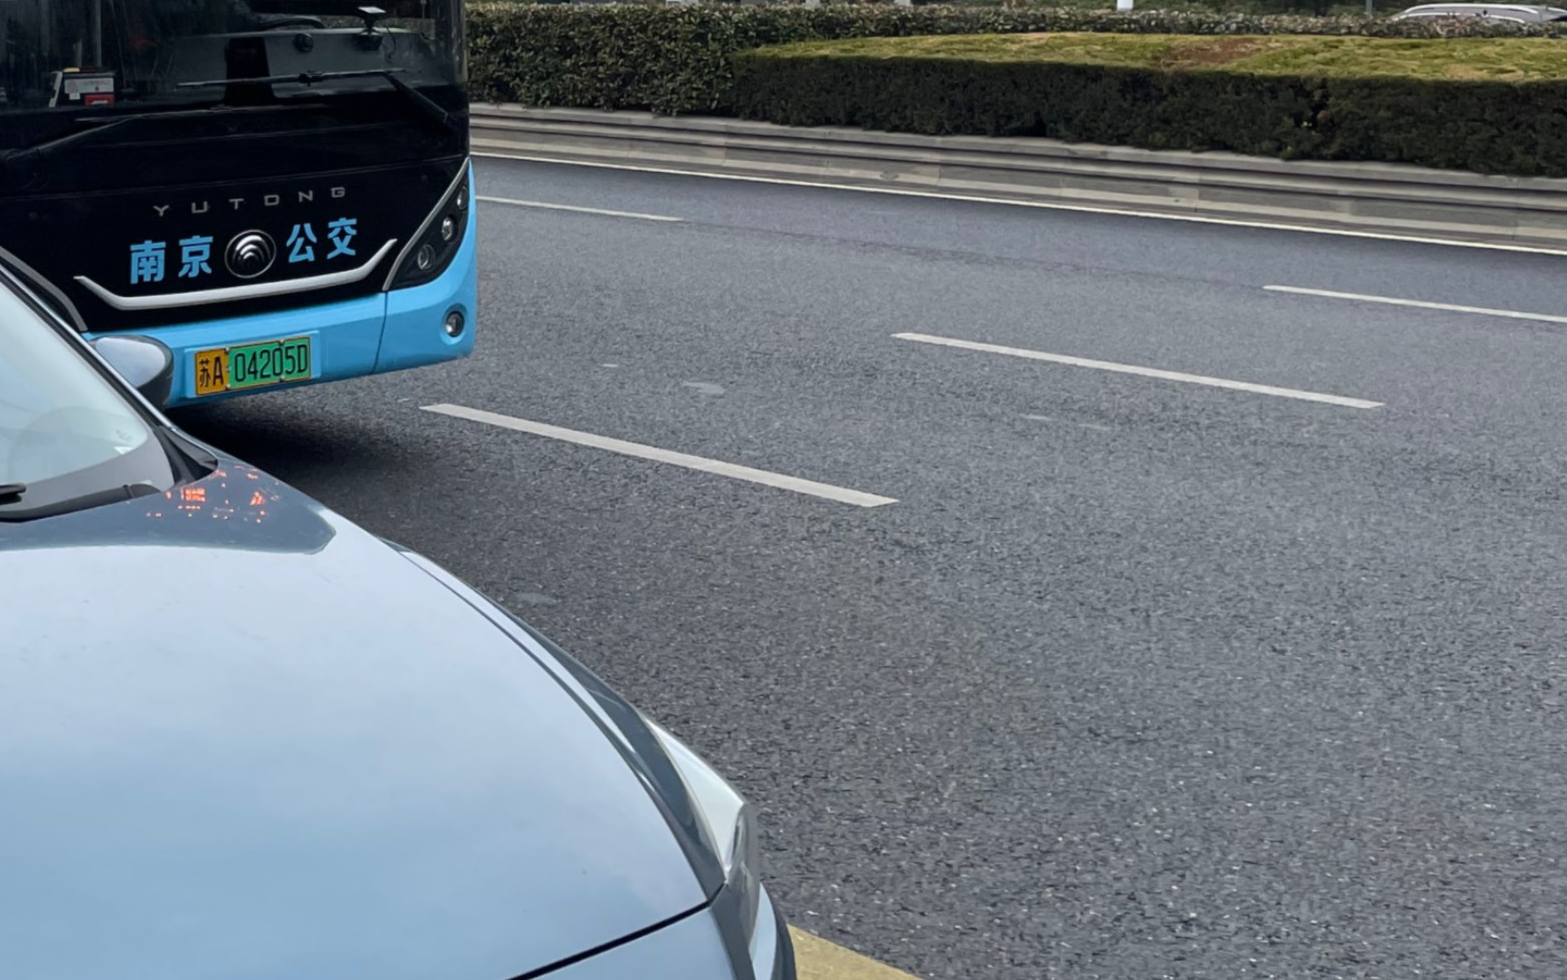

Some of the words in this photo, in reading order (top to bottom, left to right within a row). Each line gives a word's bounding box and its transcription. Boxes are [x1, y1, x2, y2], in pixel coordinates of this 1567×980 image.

[153, 186, 345, 217] YUTONG
[129, 234, 214, 285] 南京
[286, 217, 357, 264] 公交
